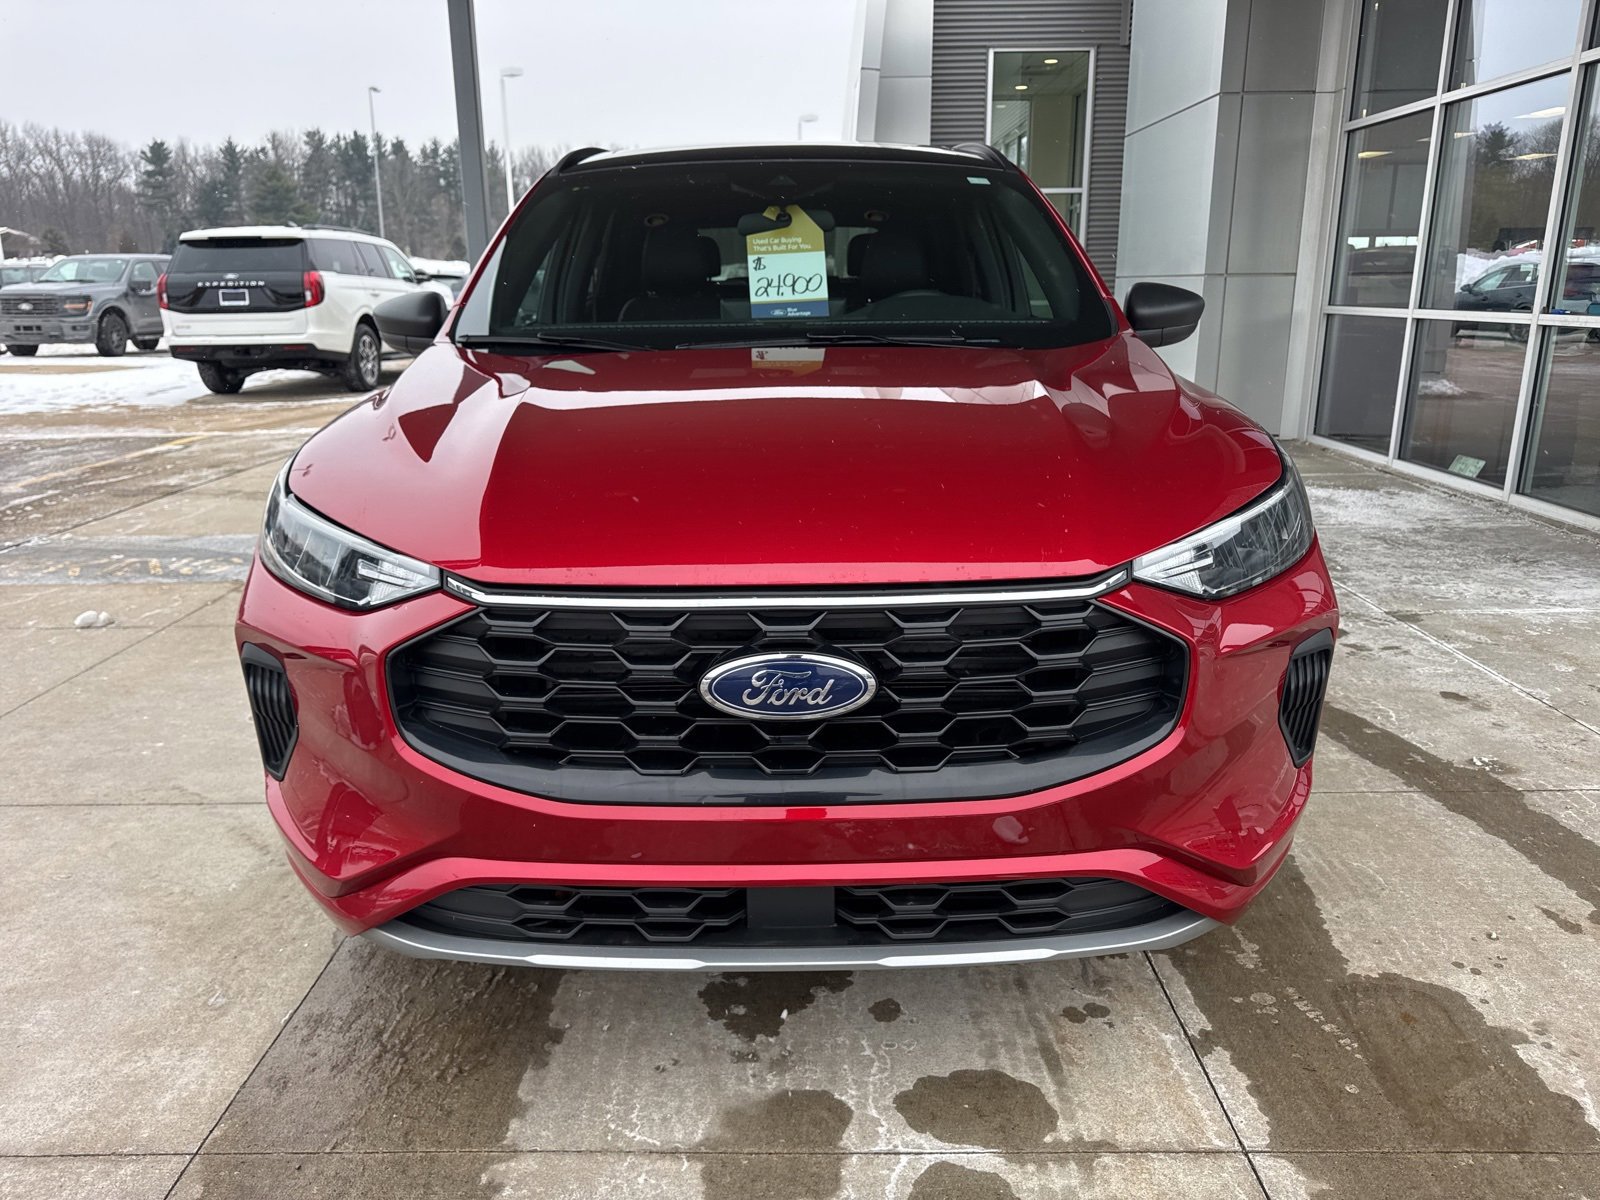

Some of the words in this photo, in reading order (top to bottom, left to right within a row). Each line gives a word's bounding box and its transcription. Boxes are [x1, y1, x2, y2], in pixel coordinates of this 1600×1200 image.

[752, 237, 769, 245] Used
[781, 236, 802, 244] Buying
[753, 244, 772, 252] That's
[742, 669, 835, 706] Ford
